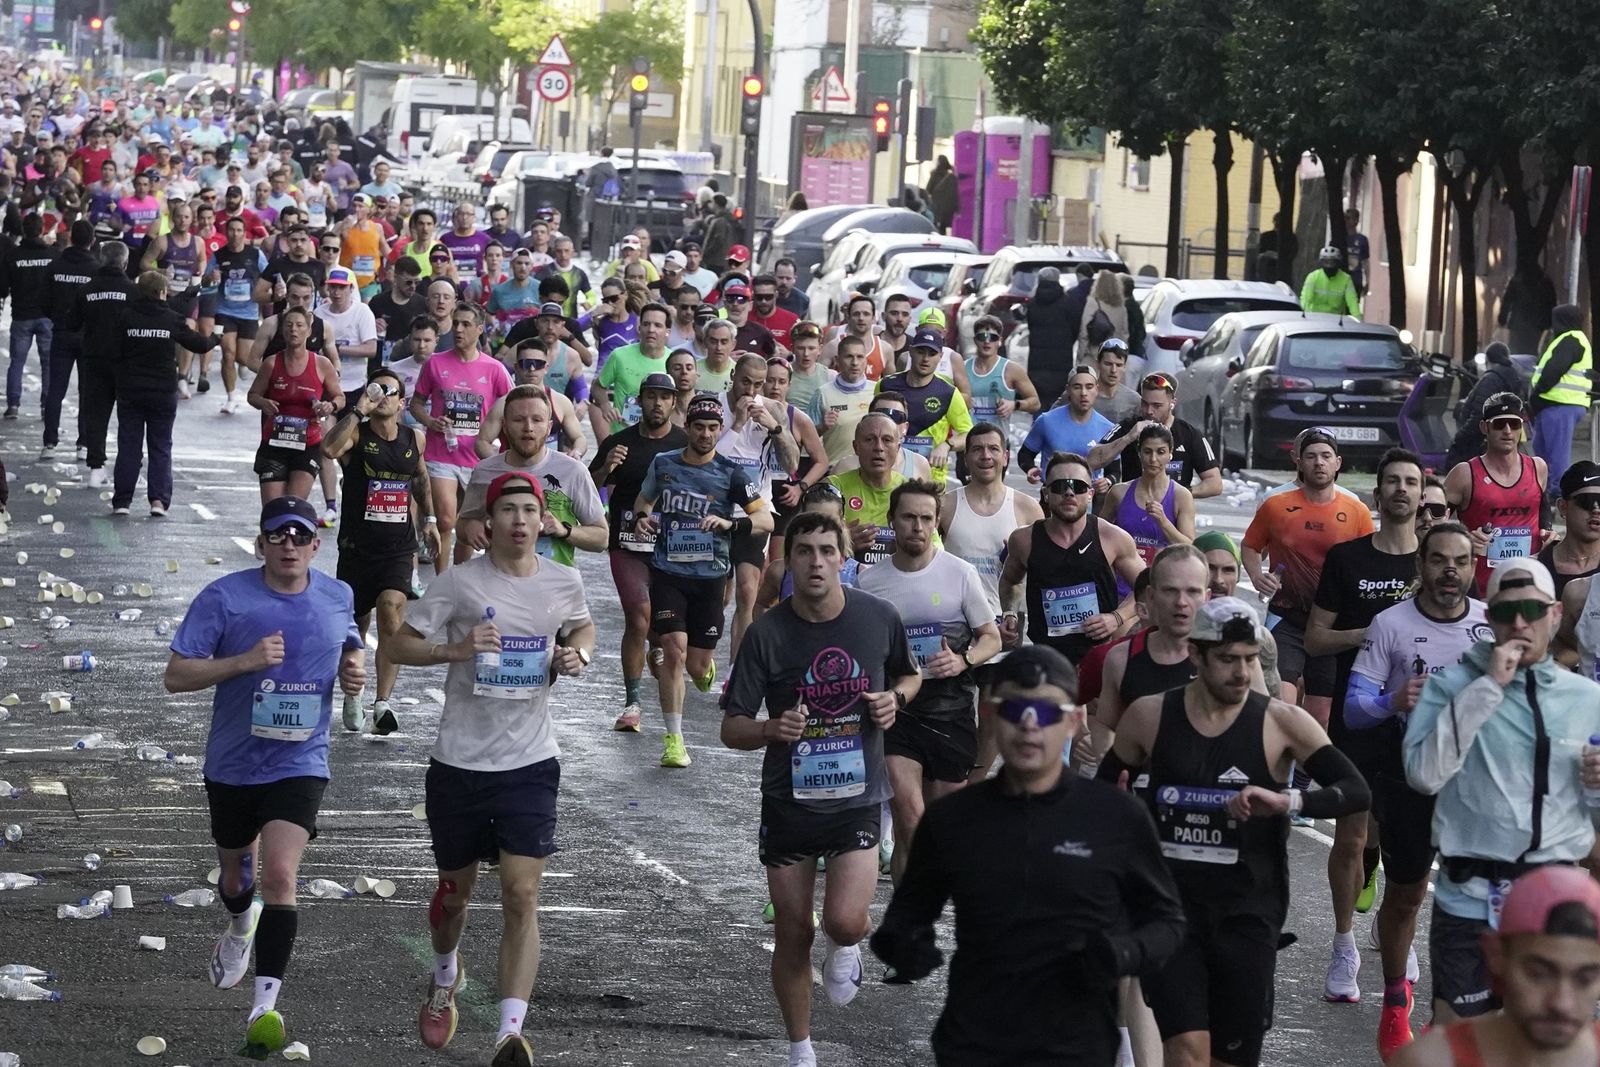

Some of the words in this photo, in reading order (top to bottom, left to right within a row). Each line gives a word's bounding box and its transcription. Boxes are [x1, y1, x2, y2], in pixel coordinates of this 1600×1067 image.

[544, 78, 565, 90] 30
[86, 292, 127, 301] VOLUNTEER
[127, 328, 171, 338] VOLUNTEER
[278, 432, 299, 440] MIEKE
[386, 505, 408, 513] VALOTO
[668, 543, 712, 552] LAVAREDA
[1500, 549, 1523, 558] ANTO
[1358, 578, 1405, 592] Sports
[1060, 586, 1089, 597] ZURICH
[1062, 603, 1078, 611] 9721
[906, 627, 934, 636] URICH
[503, 640, 541, 650] ZURICH
[502, 659, 524, 668] 5656
[280, 683, 316, 692] ZURICH
[796, 677, 871, 698] TRIASTUR
[279, 701, 300, 710] 5729
[272, 713, 303, 726] WILL
[816, 740, 854, 752] ZURICH
[817, 761, 839, 770] 5796
[804, 772, 855, 786] HEIYMA
[1184, 792, 1230, 804] ZURICH
[1185, 813, 1210, 825] 4650
[1174, 826, 1222, 845] PAOLO
